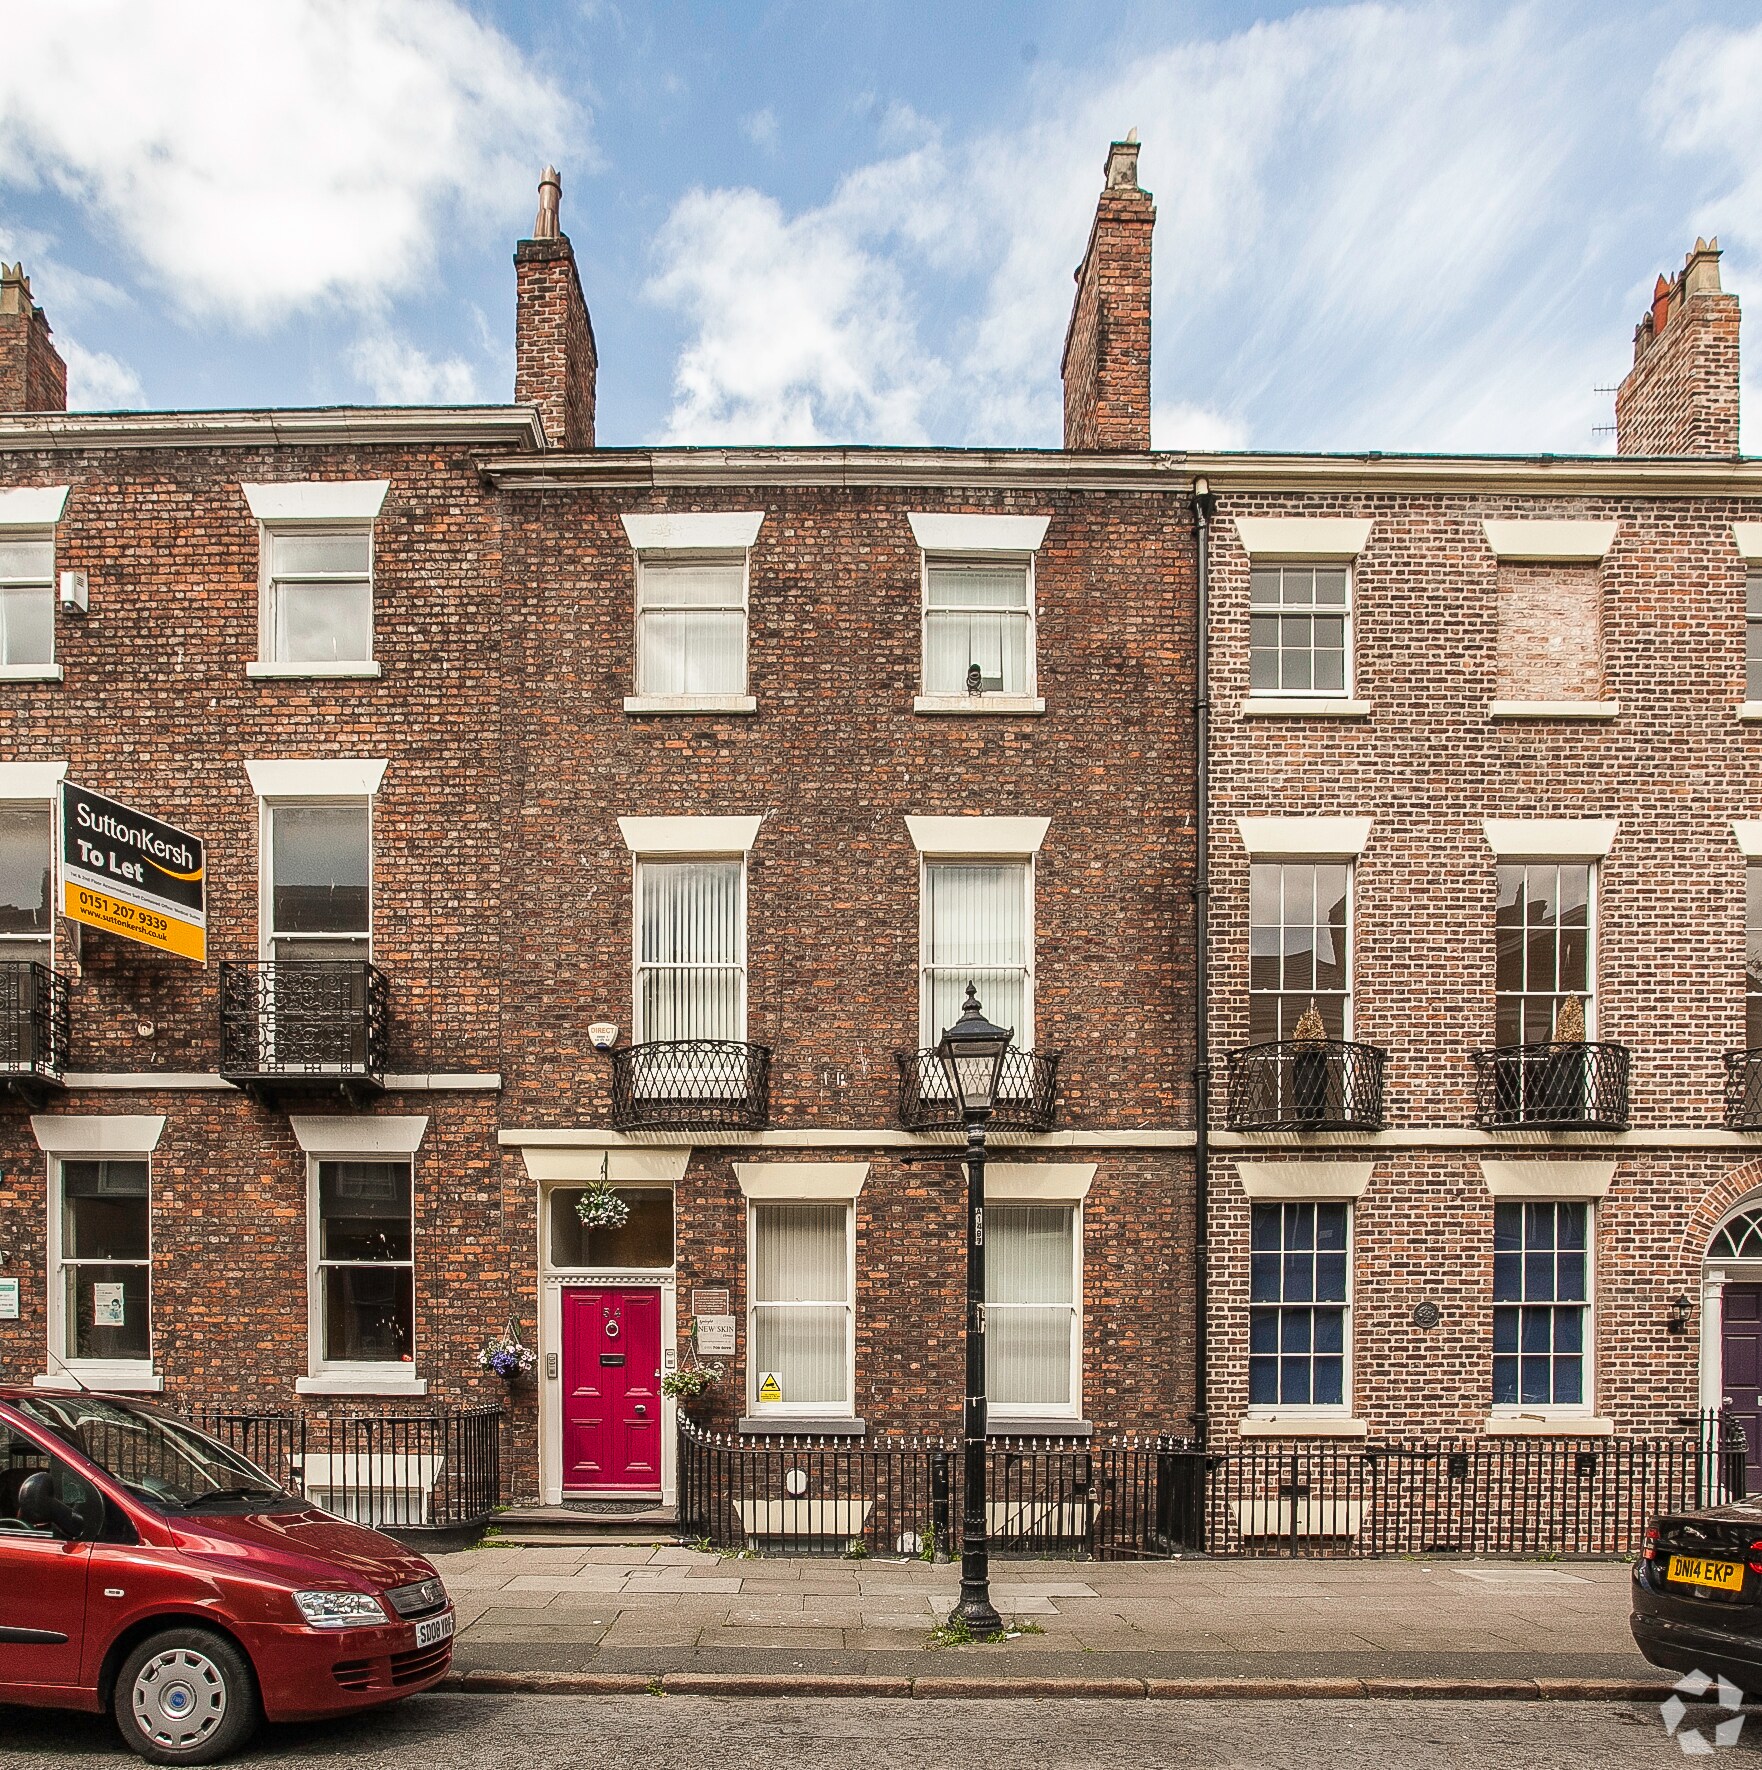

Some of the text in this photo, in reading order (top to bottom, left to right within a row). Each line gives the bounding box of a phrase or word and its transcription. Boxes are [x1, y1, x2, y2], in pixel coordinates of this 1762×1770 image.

[77, 802, 193, 870] SuttonKersh
[77, 838, 144, 883] To Let
[79, 891, 168, 931] 0151 207 9339
[79, 906, 168, 942] www.suttonkersh.co.uk
[698, 1325, 734, 1333] NEW SKIN
[1674, 1559, 1734, 1582] DN14 EKP
[420, 1621, 440, 1643] SD08
